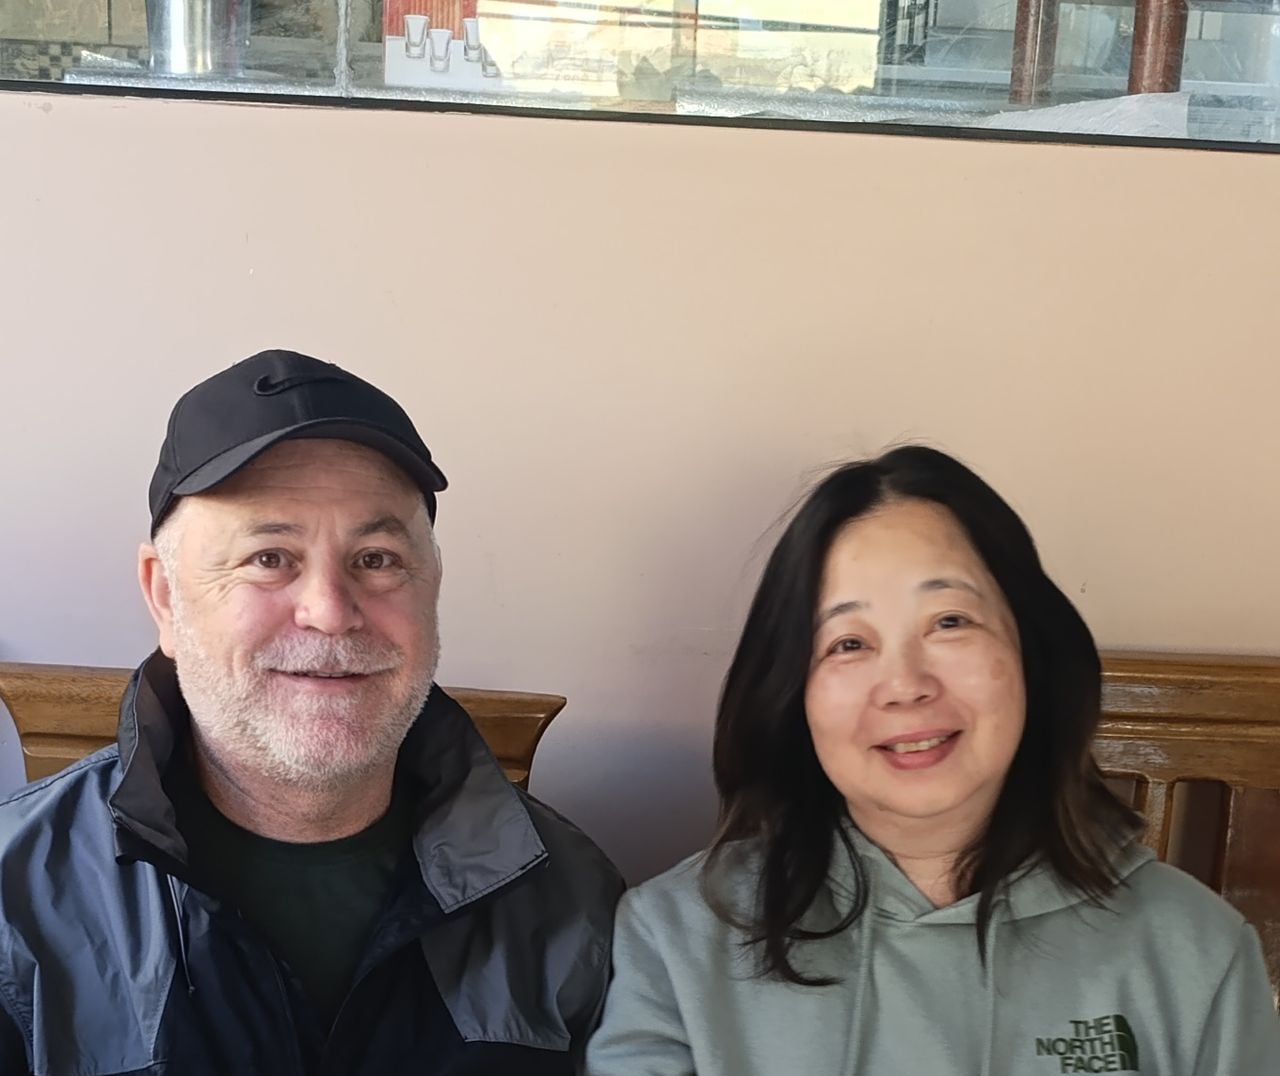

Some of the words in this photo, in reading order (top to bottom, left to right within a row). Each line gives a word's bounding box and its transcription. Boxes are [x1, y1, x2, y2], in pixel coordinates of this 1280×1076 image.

[1069, 1015, 1113, 1037] THE
[1035, 1034, 1115, 1056] NORTH
[1059, 1054, 1119, 1073] FACE
